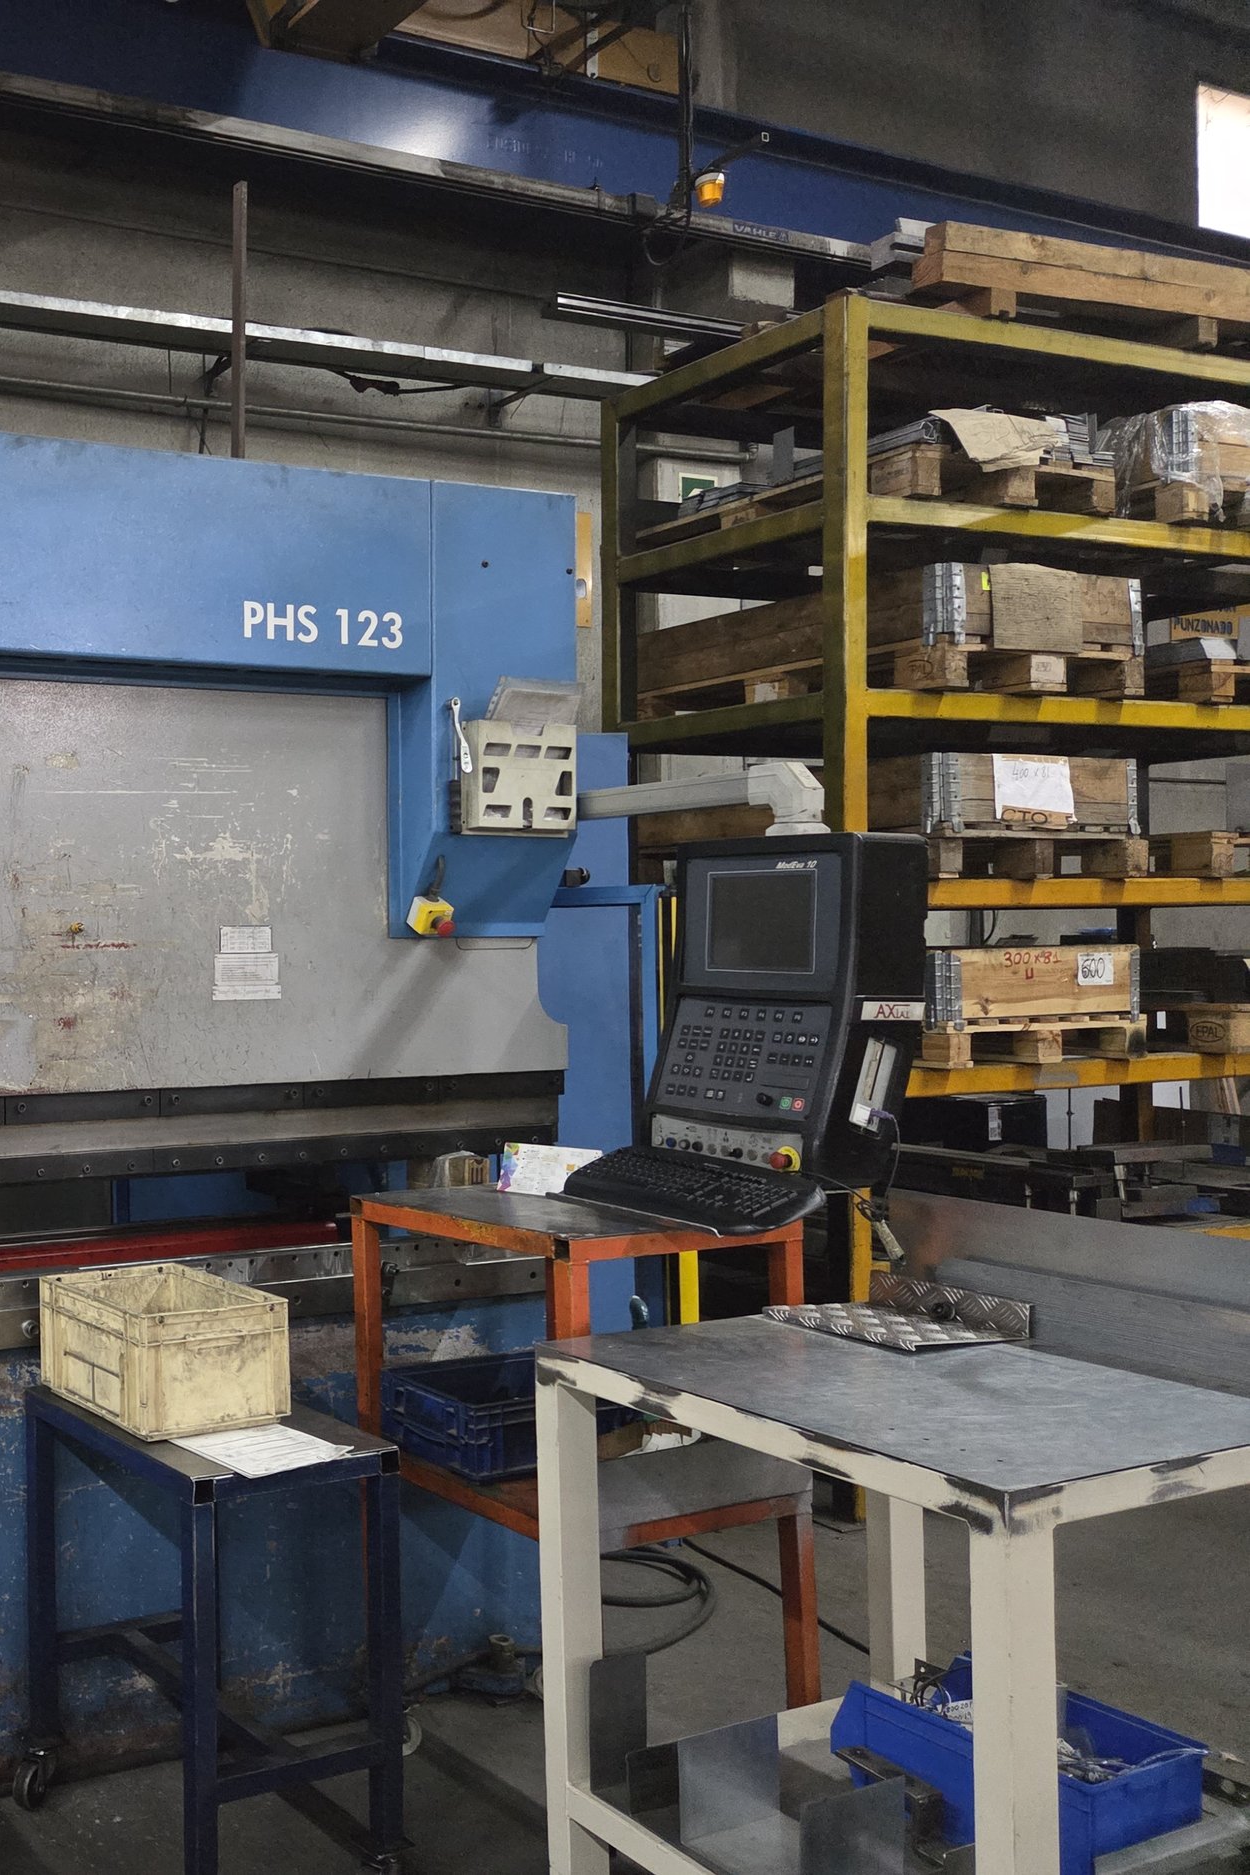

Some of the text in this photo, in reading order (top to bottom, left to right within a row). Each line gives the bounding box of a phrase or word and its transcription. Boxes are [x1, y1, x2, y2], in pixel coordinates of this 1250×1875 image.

[734, 223, 777, 241] VAHLE
[243, 600, 404, 649] PHS 123
[806, 859, 818, 868] 10
[1195, 1025, 1219, 1039] EPAL
